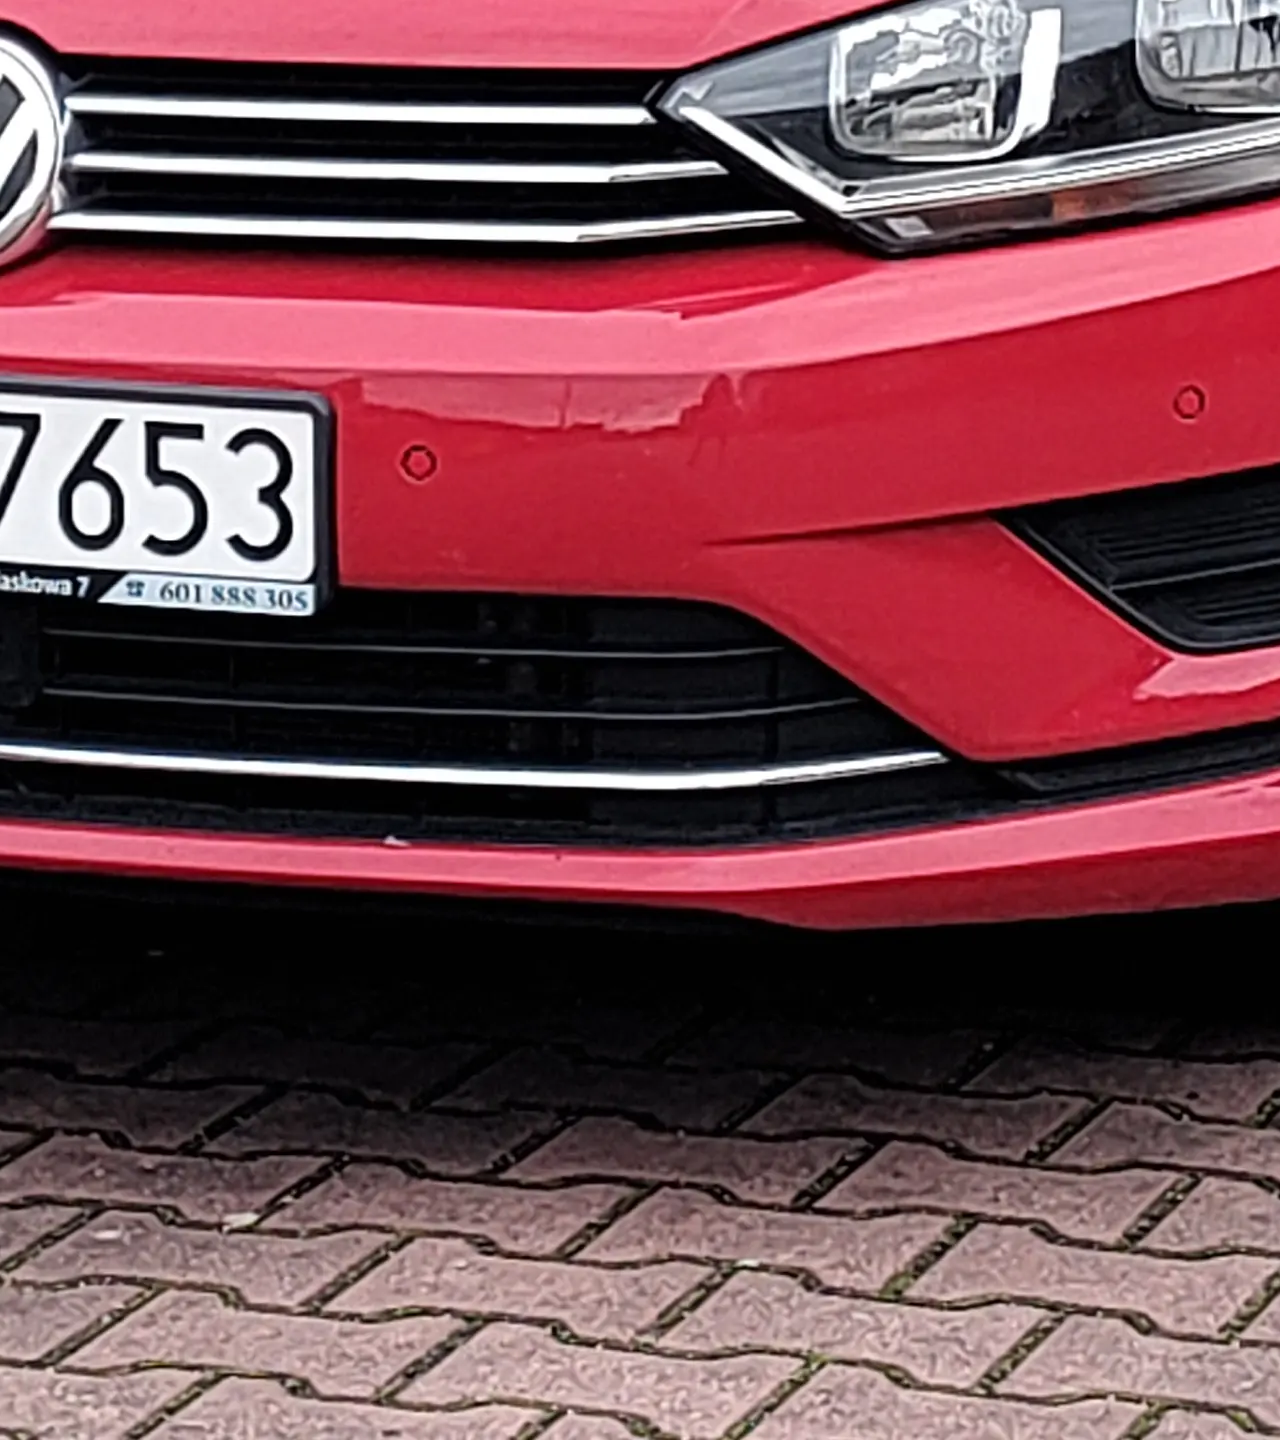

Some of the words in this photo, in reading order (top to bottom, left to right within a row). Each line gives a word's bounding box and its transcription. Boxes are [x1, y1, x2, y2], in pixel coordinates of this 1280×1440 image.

[76, 576, 90, 598] 7
[159, 580, 202, 604] 601
[211, 585, 257, 608] 888
[266, 589, 309, 611] 305
